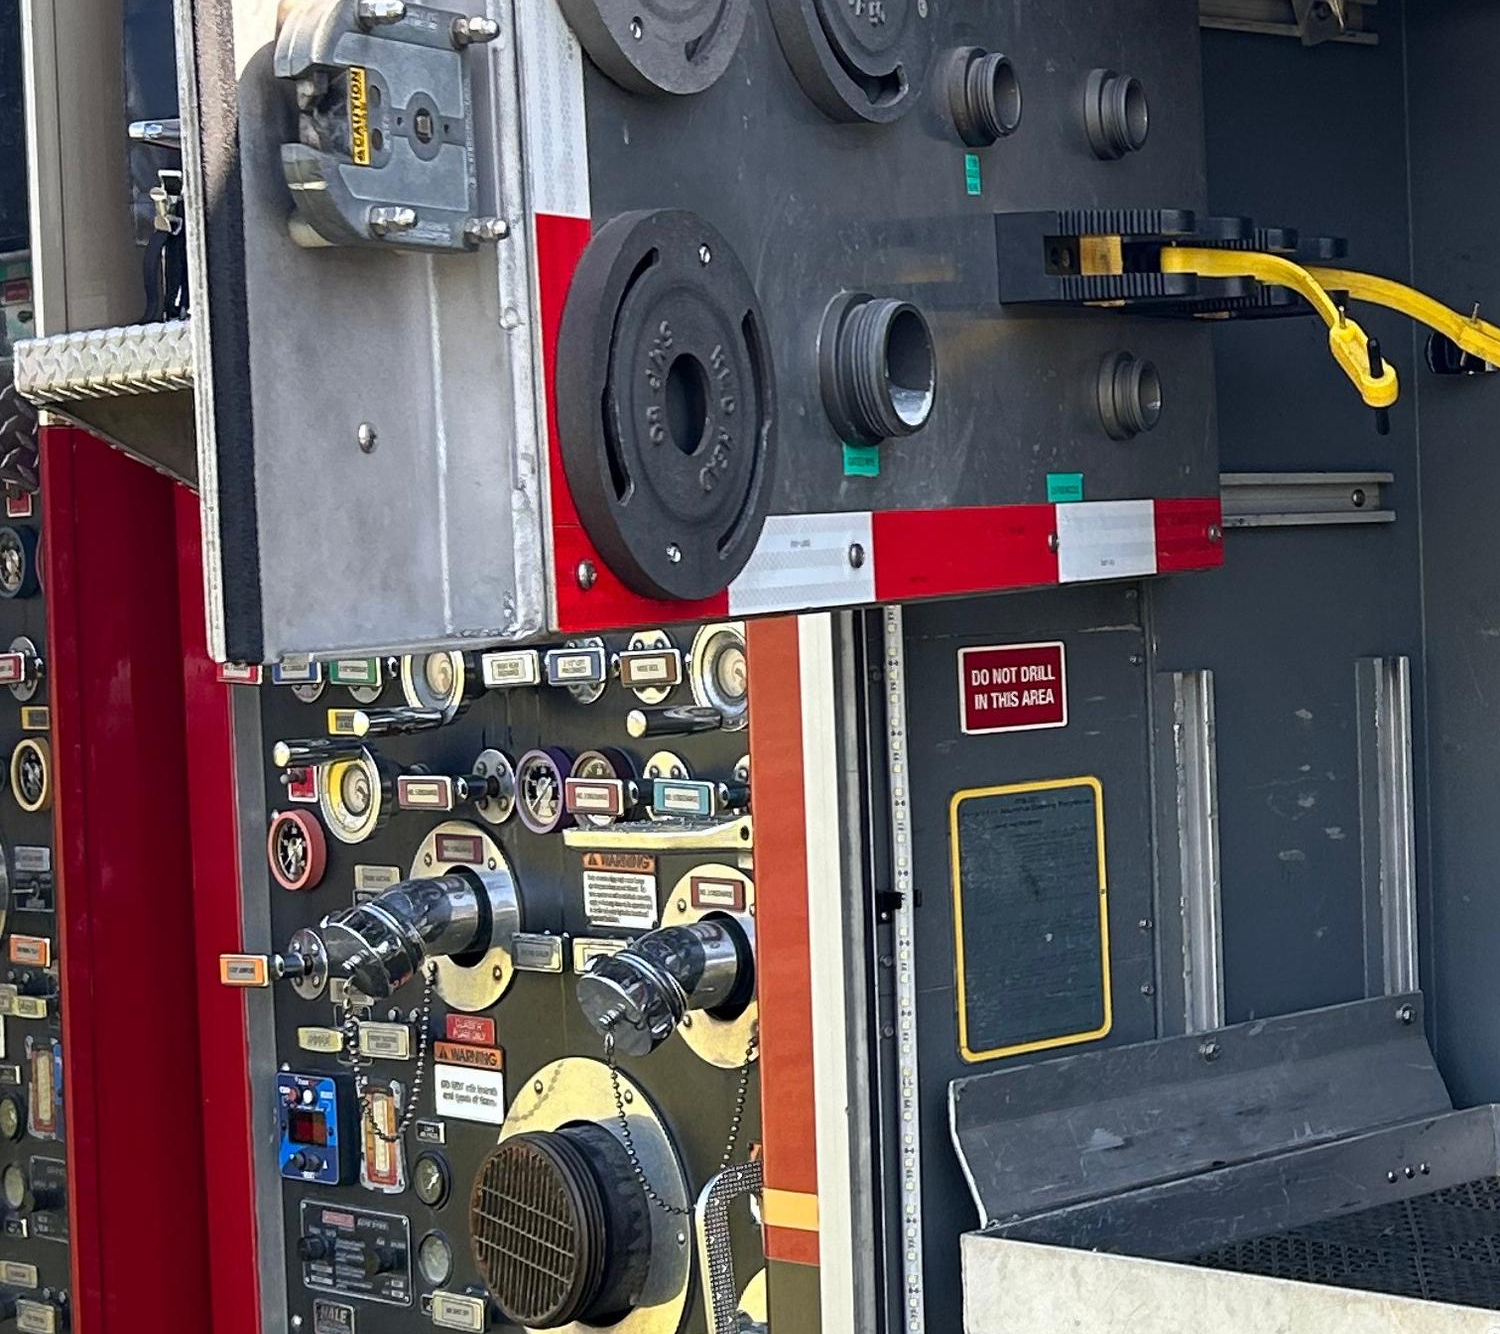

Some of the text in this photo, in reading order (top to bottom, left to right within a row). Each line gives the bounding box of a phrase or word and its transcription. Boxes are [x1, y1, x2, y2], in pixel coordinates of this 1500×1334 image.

[350, 69, 364, 148] CAUTION
[971, 664, 1055, 686] DO NOT DRILL
[974, 688, 1054, 710] IN THIS AREA
[601, 854, 650, 868] WARNING
[451, 1047, 497, 1066] WARNING
[320, 1306, 348, 1324] HALE
